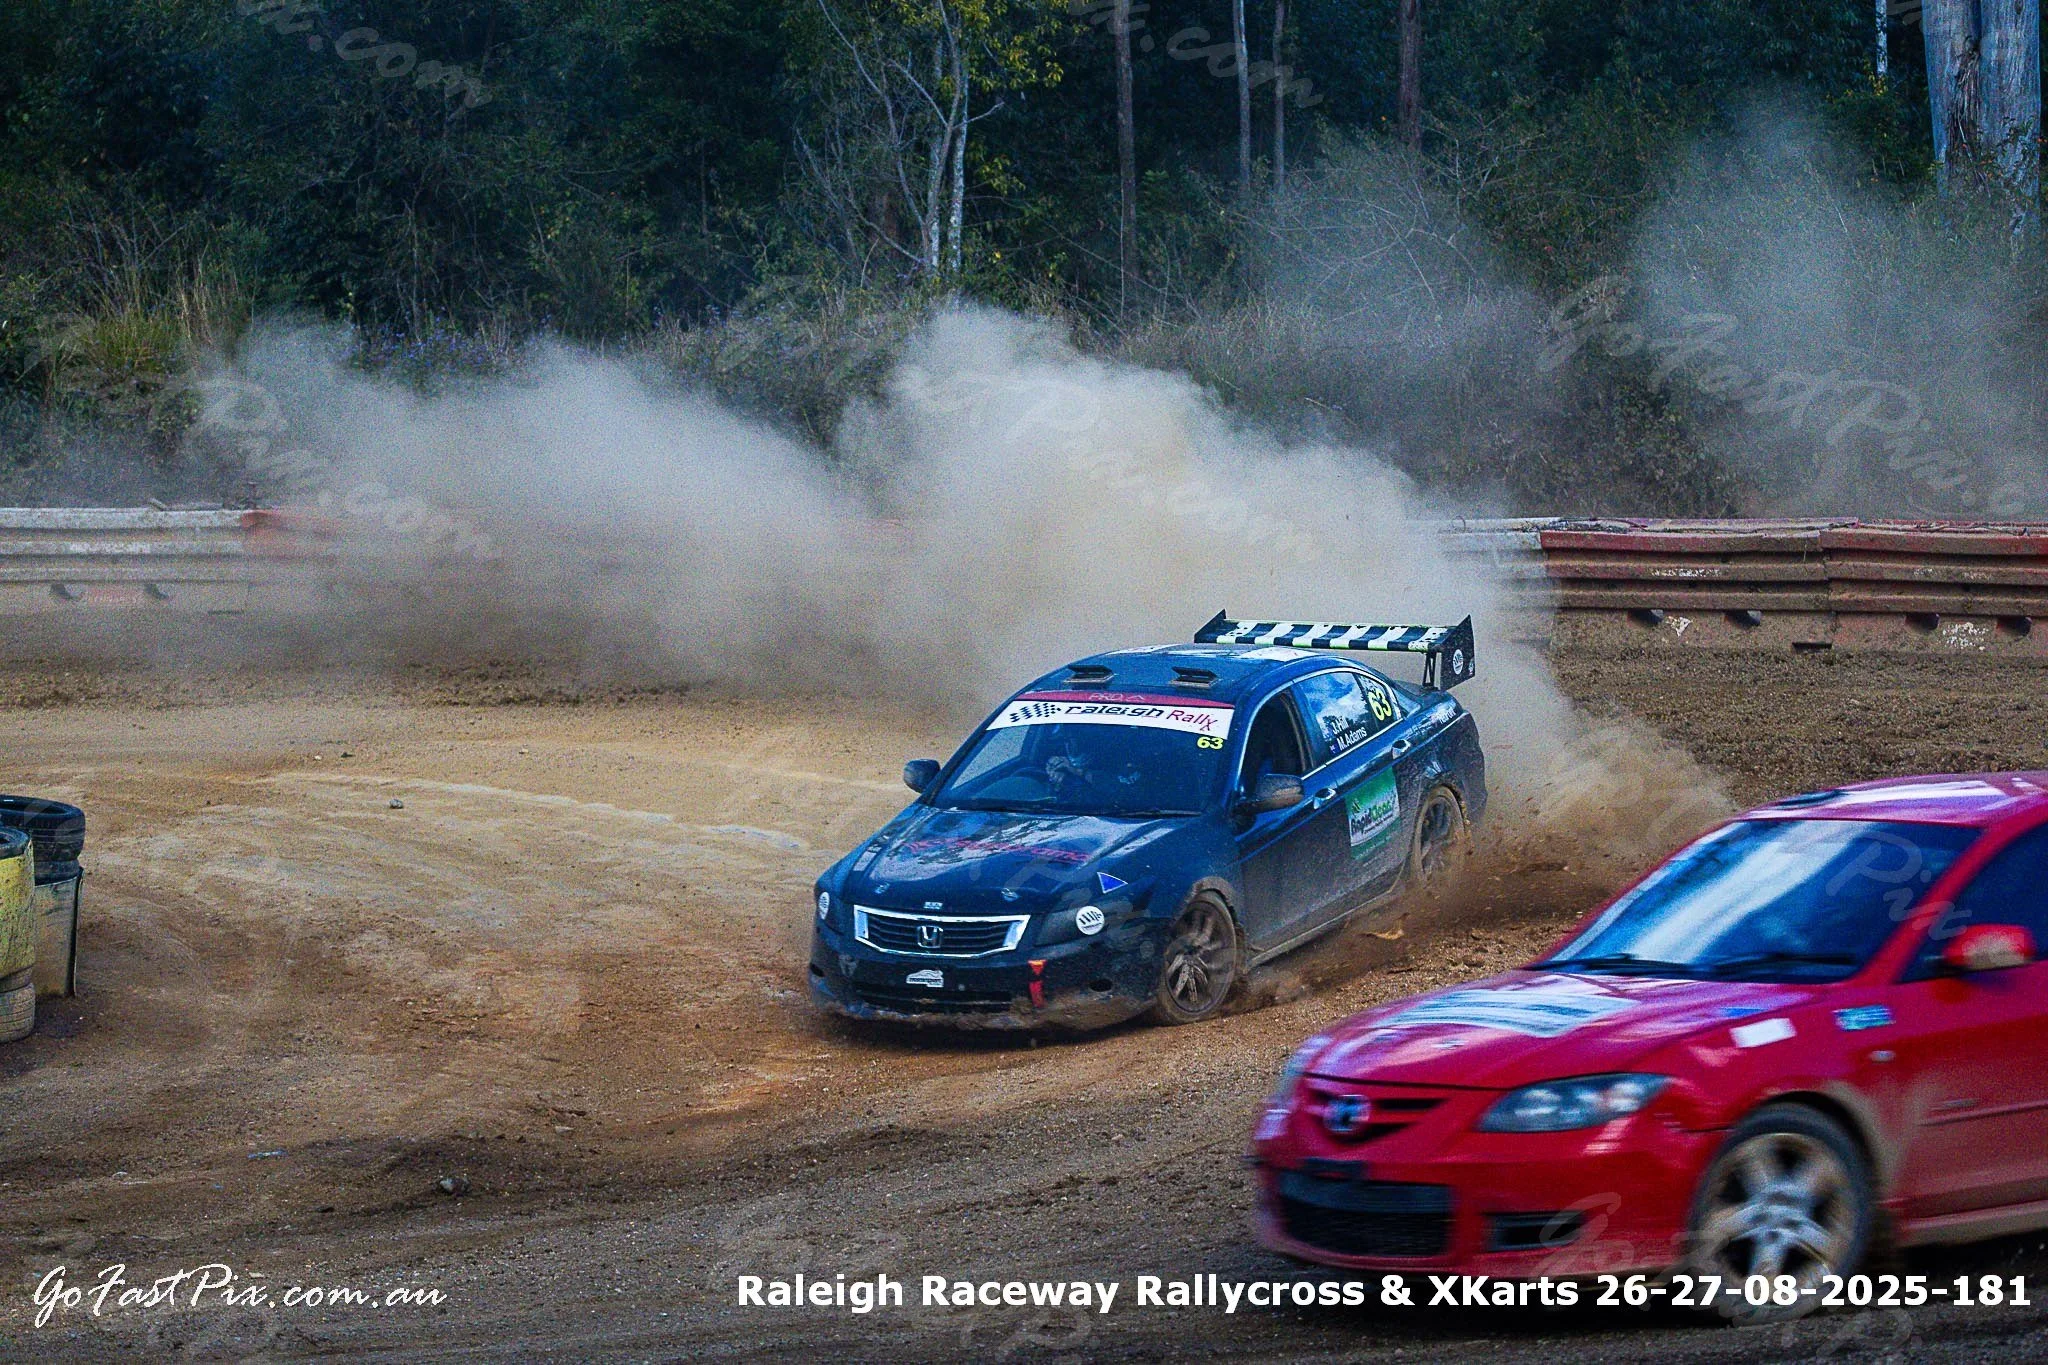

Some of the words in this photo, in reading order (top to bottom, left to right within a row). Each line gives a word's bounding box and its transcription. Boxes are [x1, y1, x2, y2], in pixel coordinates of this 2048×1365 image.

[1065, 705, 1165, 717] raleigh
[1368, 688, 1393, 721] 63
[1197, 736, 1224, 750] 63
[1337, 726, 1368, 751] M.Adams
